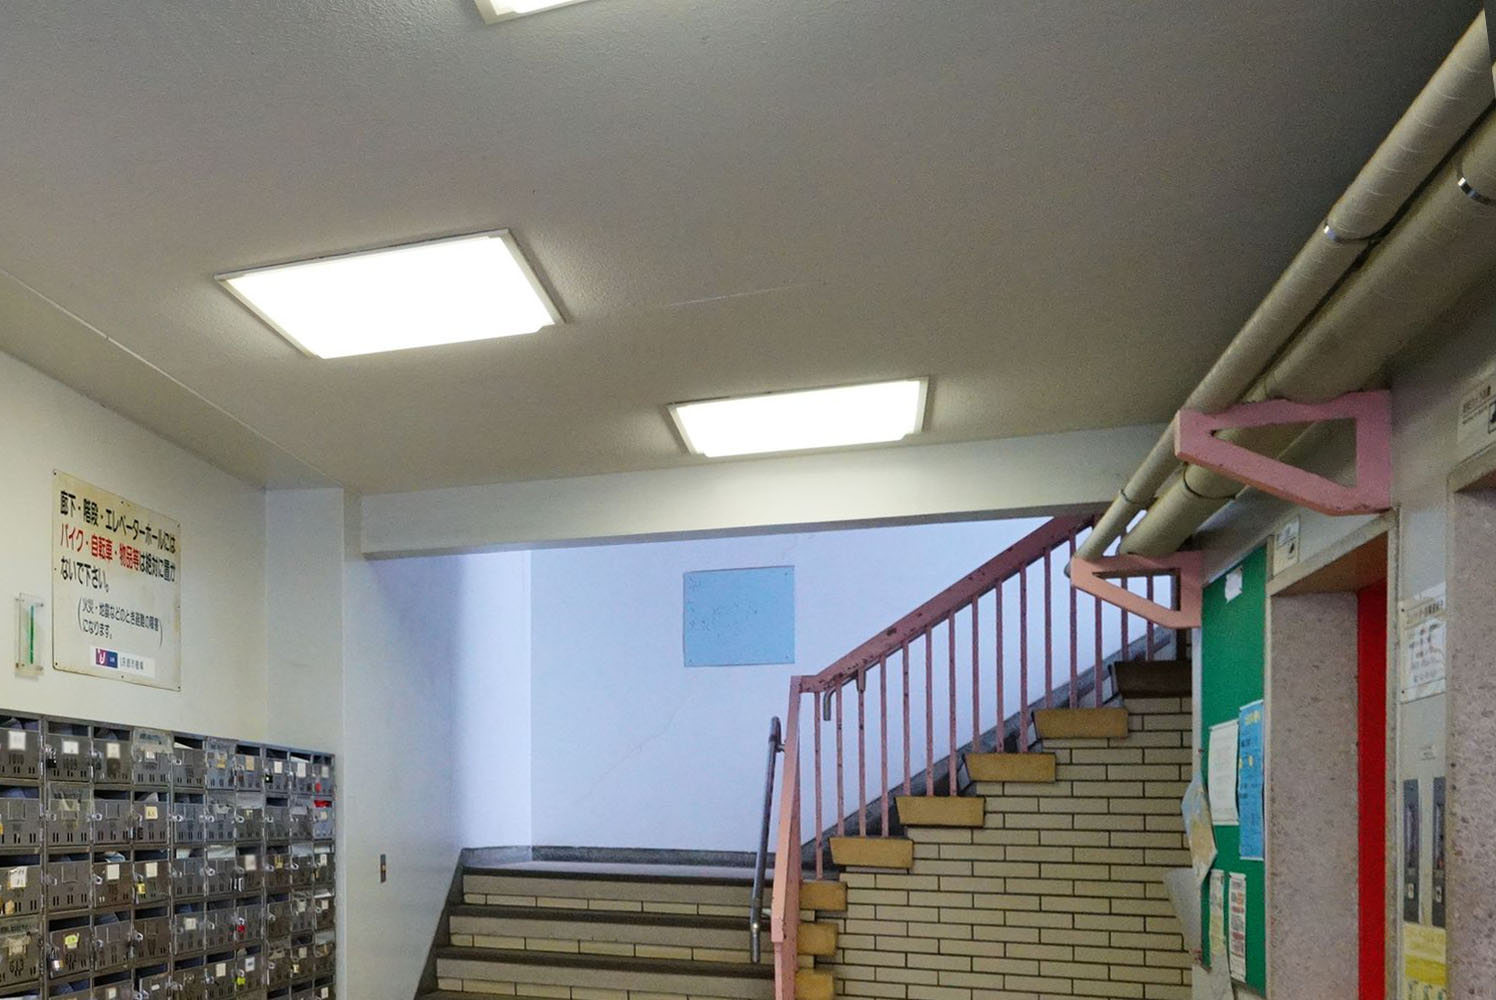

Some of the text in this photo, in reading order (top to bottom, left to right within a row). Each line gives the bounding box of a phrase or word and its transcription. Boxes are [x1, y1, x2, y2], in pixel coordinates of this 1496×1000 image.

[61, 555, 109, 592] ないで下さい。
